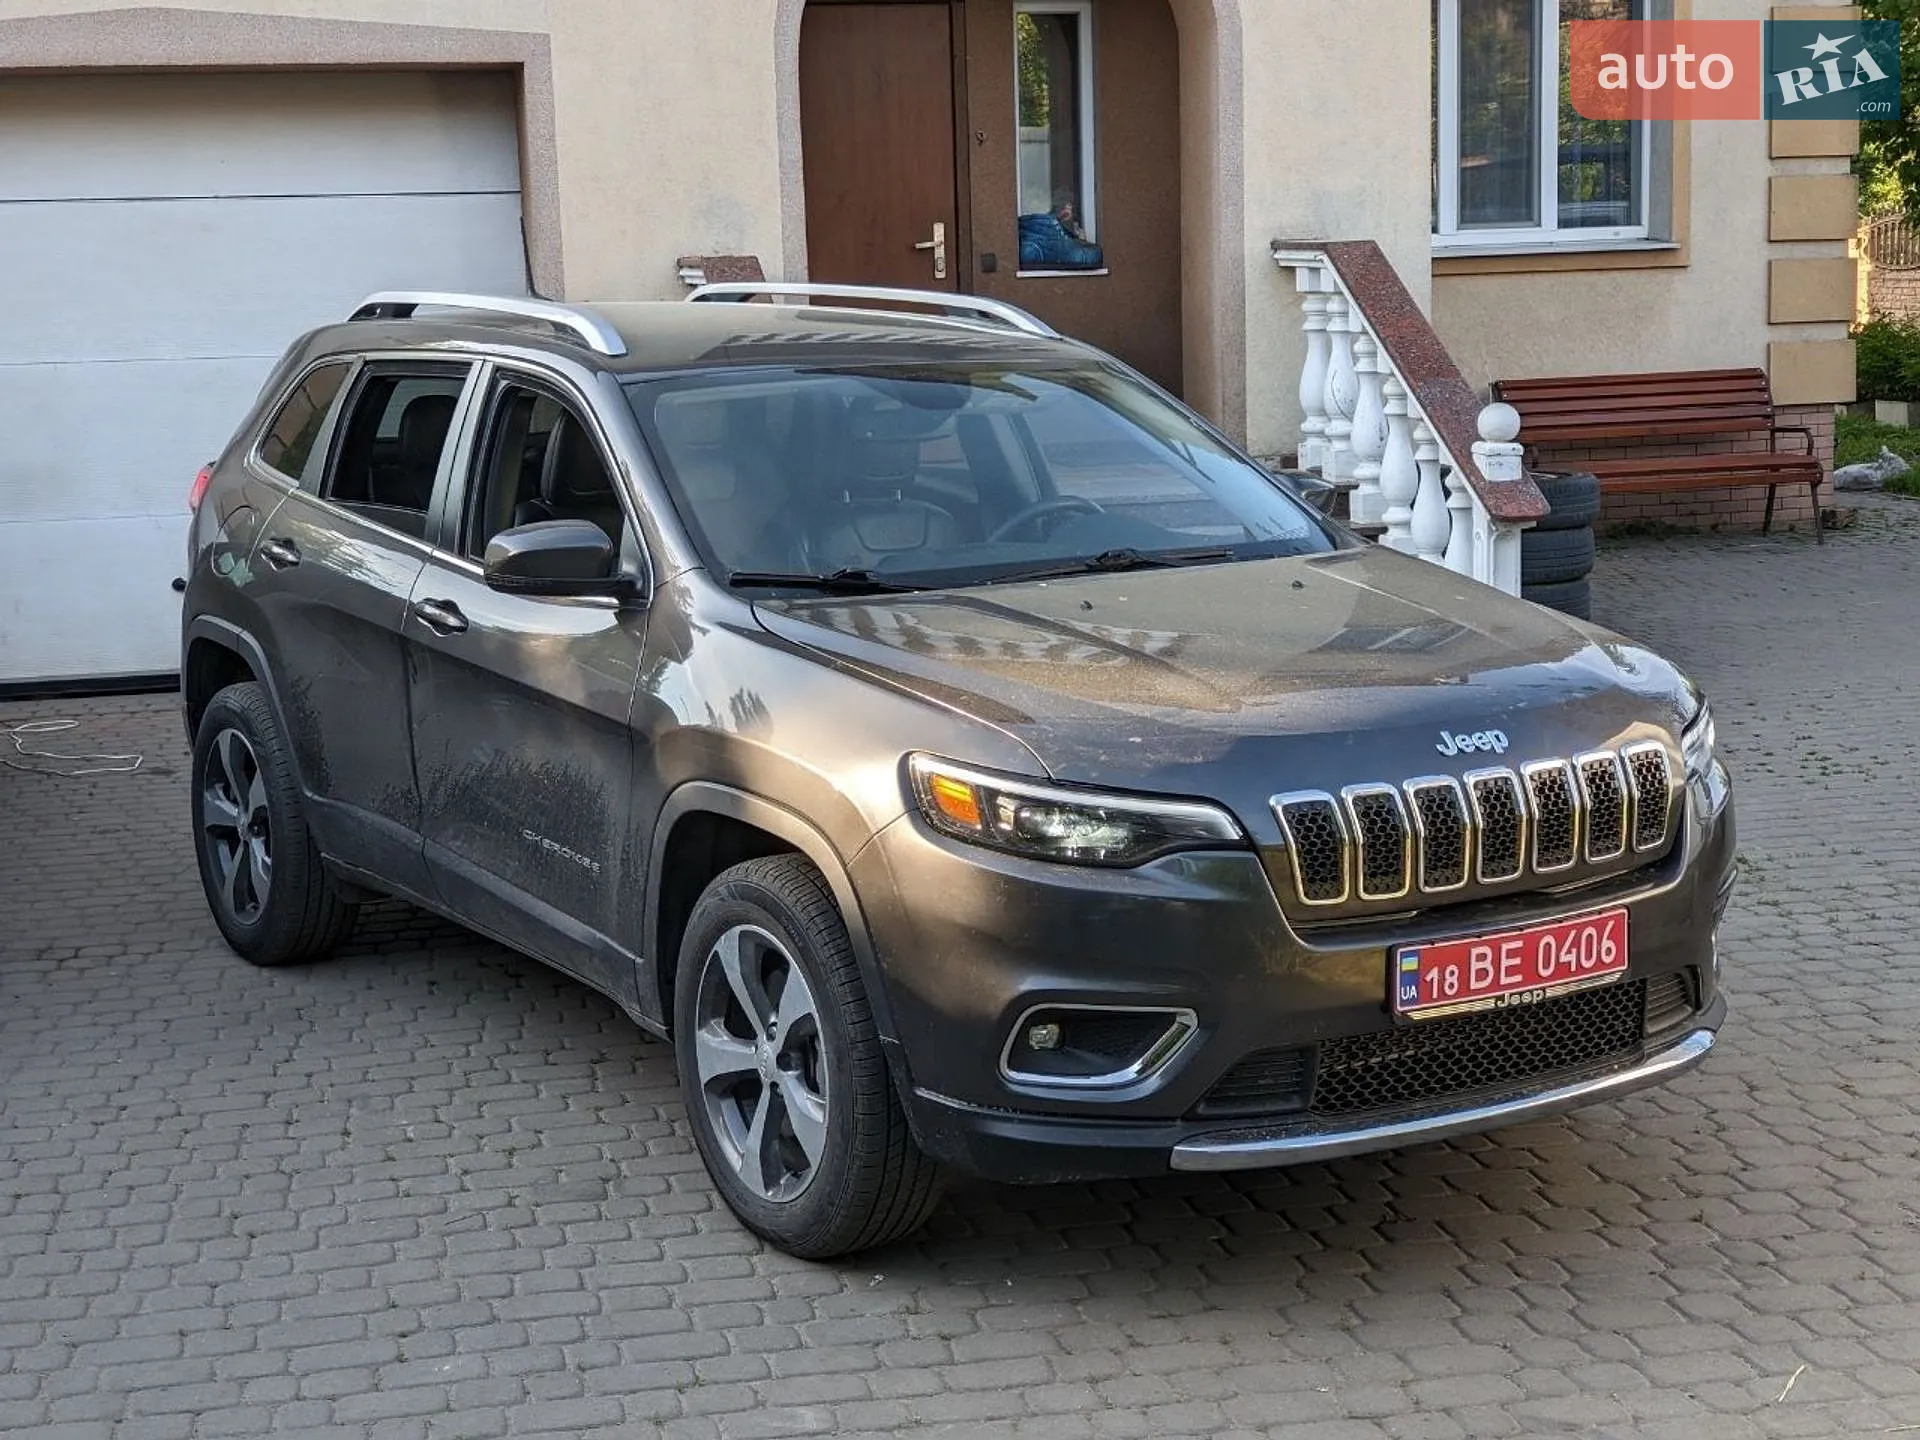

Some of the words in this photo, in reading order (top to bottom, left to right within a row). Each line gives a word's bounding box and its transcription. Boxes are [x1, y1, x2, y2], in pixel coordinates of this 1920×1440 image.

[1435, 729, 1509, 756] Jeep
[1424, 964, 1460, 999] 18
[1469, 940, 1525, 990] BE
[1537, 919, 1616, 978] 0406
[1401, 986, 1418, 1000] UA
[1497, 988, 1547, 1007] Jeep
